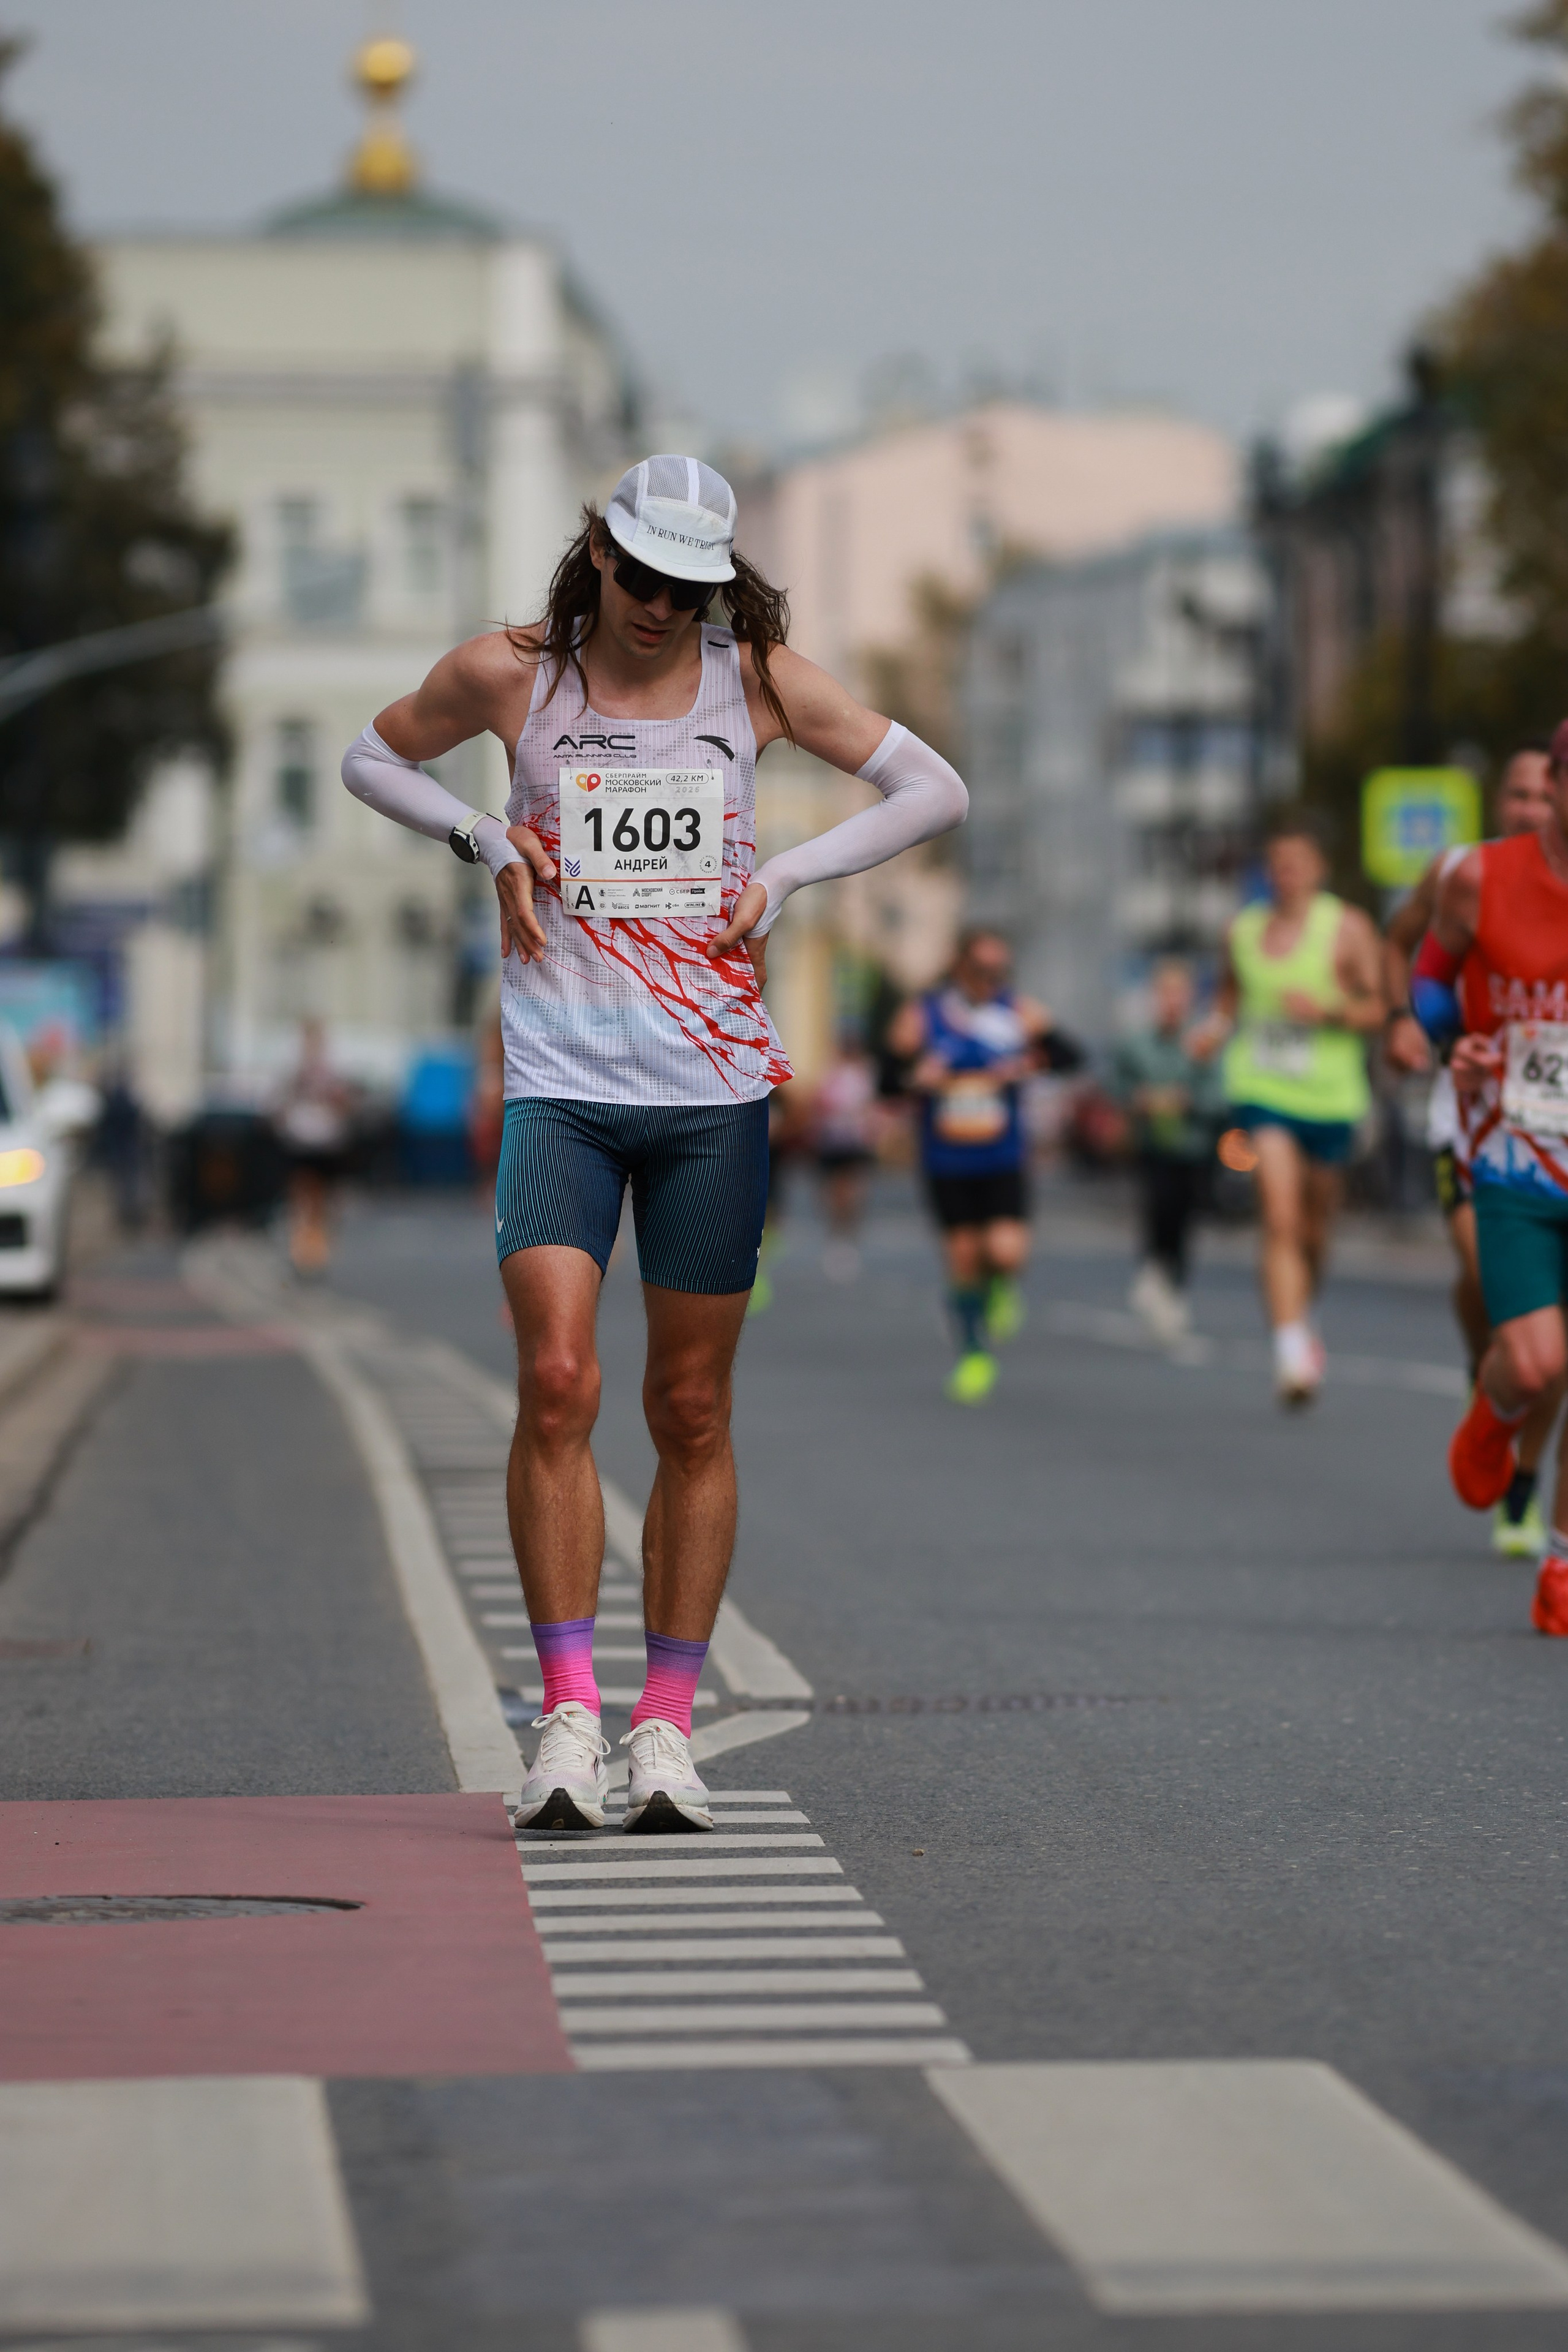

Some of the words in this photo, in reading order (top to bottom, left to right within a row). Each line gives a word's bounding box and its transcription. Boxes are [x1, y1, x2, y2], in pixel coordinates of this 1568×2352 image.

[647, 525, 657, 535] IN
[658, 528, 677, 541] RUN
[679, 534, 694, 546] WE
[694, 538, 716, 550] TRUST
[553, 734, 636, 750] ARC
[584, 807, 701, 852] 1603
[614, 856, 668, 872] АНДРЕЙ
[1523, 1050, 1568, 1087] 62
